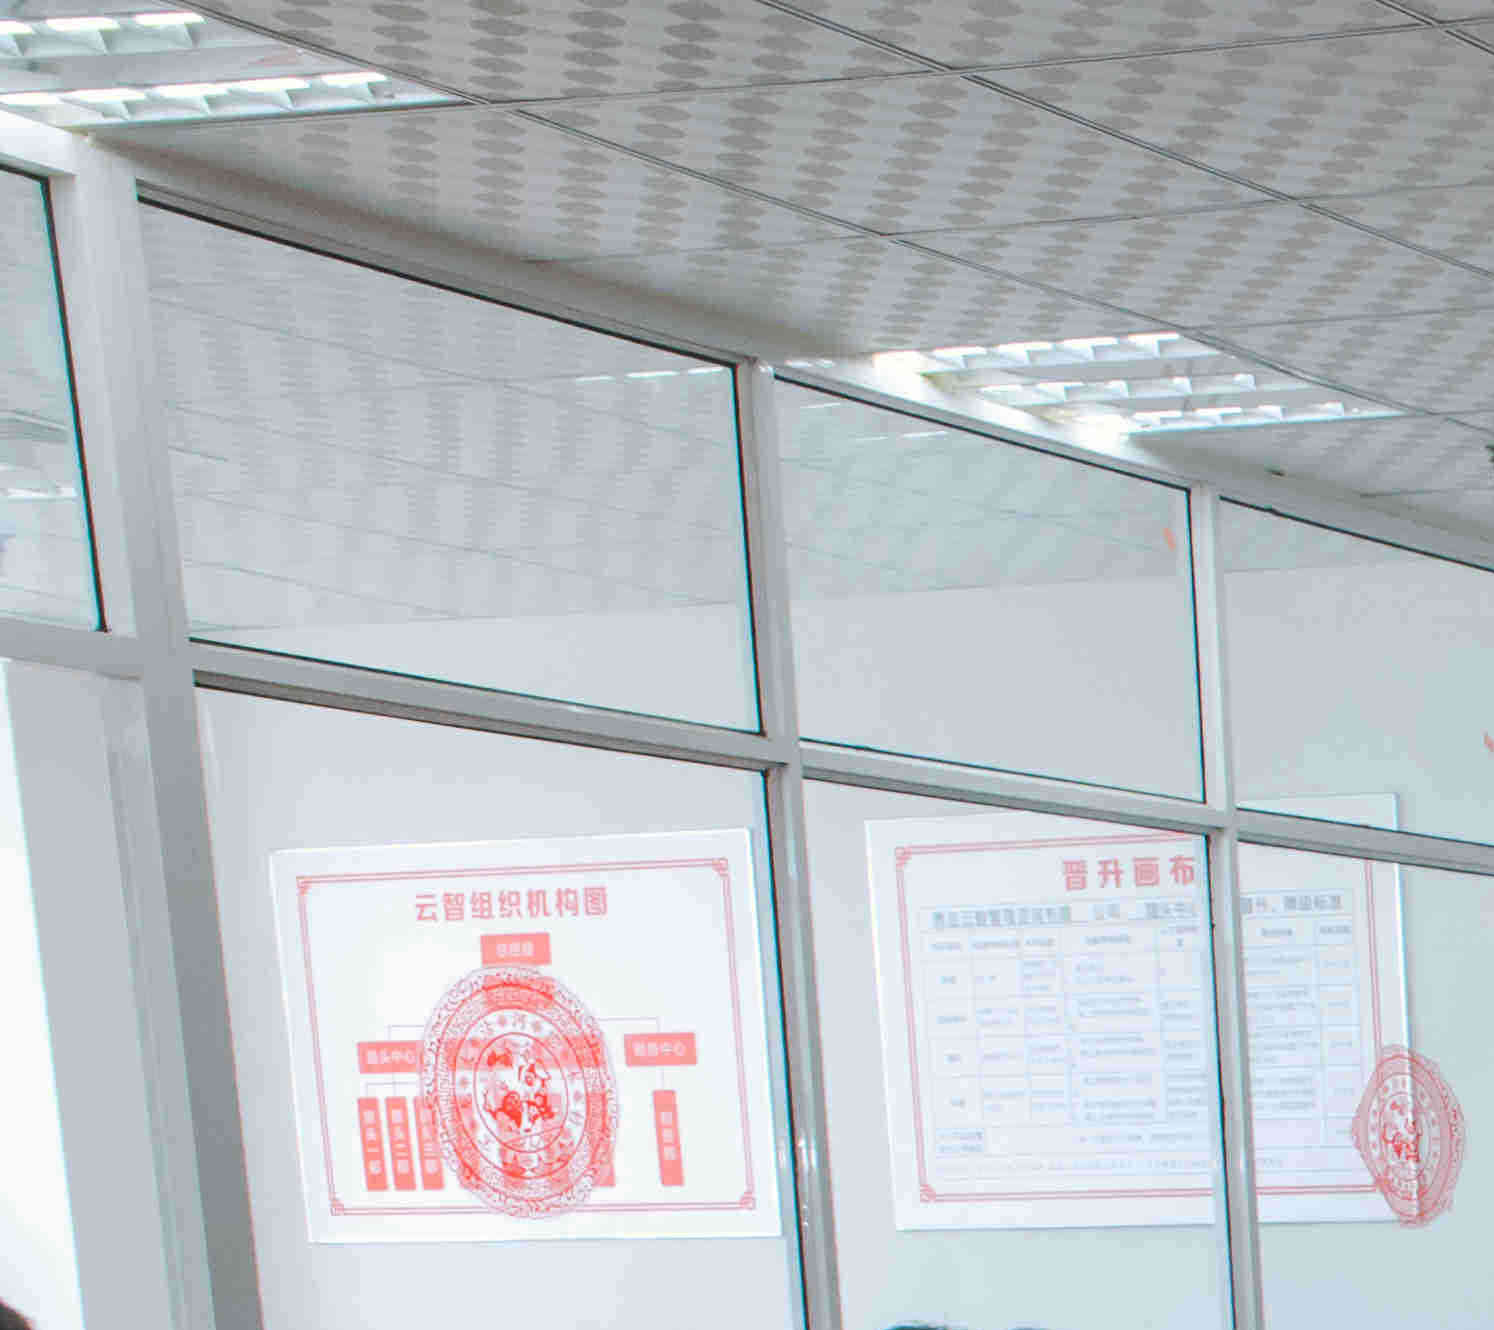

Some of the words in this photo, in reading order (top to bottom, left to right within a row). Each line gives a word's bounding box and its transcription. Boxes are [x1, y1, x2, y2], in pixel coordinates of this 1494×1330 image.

[415, 886, 608, 922] 云智组织机构图
